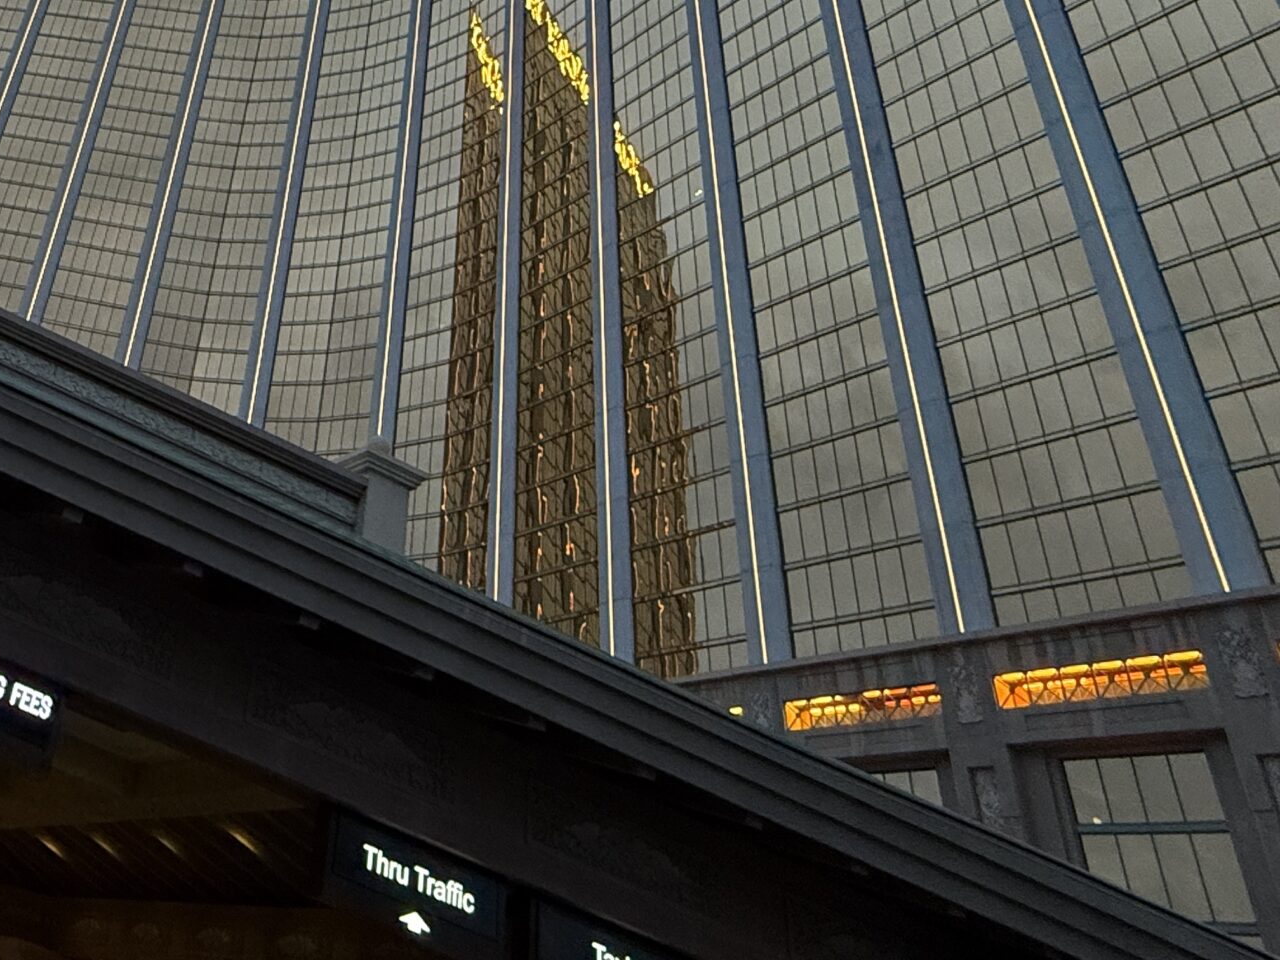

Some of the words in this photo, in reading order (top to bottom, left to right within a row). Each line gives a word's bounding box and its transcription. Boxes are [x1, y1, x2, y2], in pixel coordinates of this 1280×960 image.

[8, 681, 54, 720] FEES
[363, 843, 410, 887] Thru
[413, 865, 475, 914] Traffic
